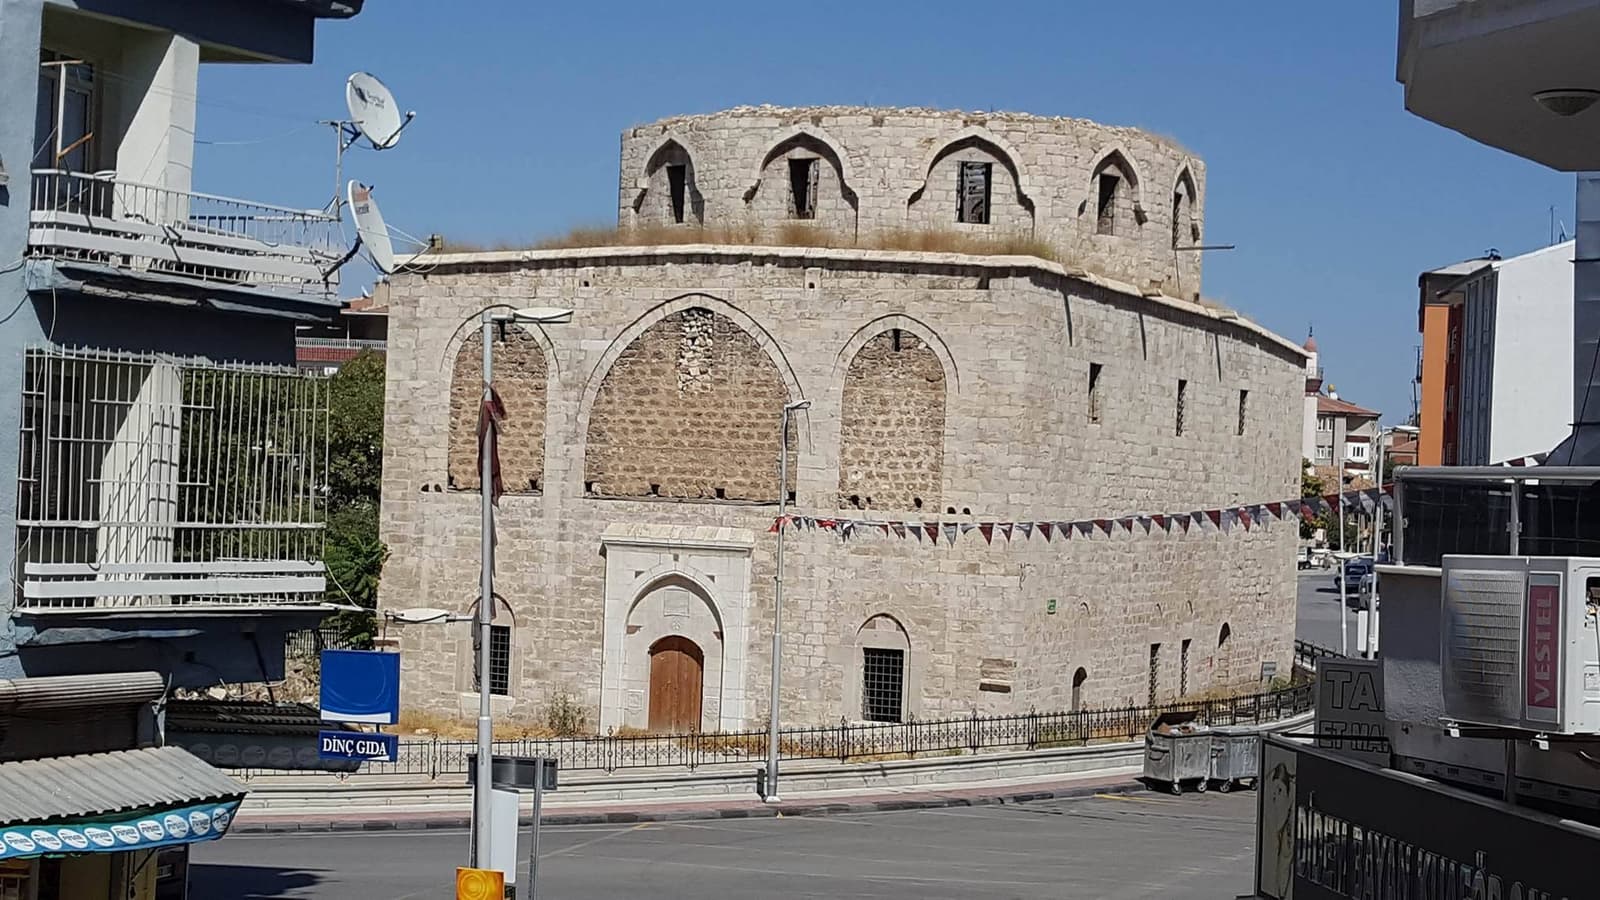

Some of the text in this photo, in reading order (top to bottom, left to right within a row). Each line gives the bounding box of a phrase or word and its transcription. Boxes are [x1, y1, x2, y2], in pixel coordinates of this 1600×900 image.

[1535, 592, 1553, 704] VESTEL
[1325, 669, 1384, 712] TA
[322, 735, 354, 757] DİNÇ
[356, 740, 388, 755] GIDA
[1319, 720, 1347, 749] ET
[1352, 824, 1412, 900] BAYAN
